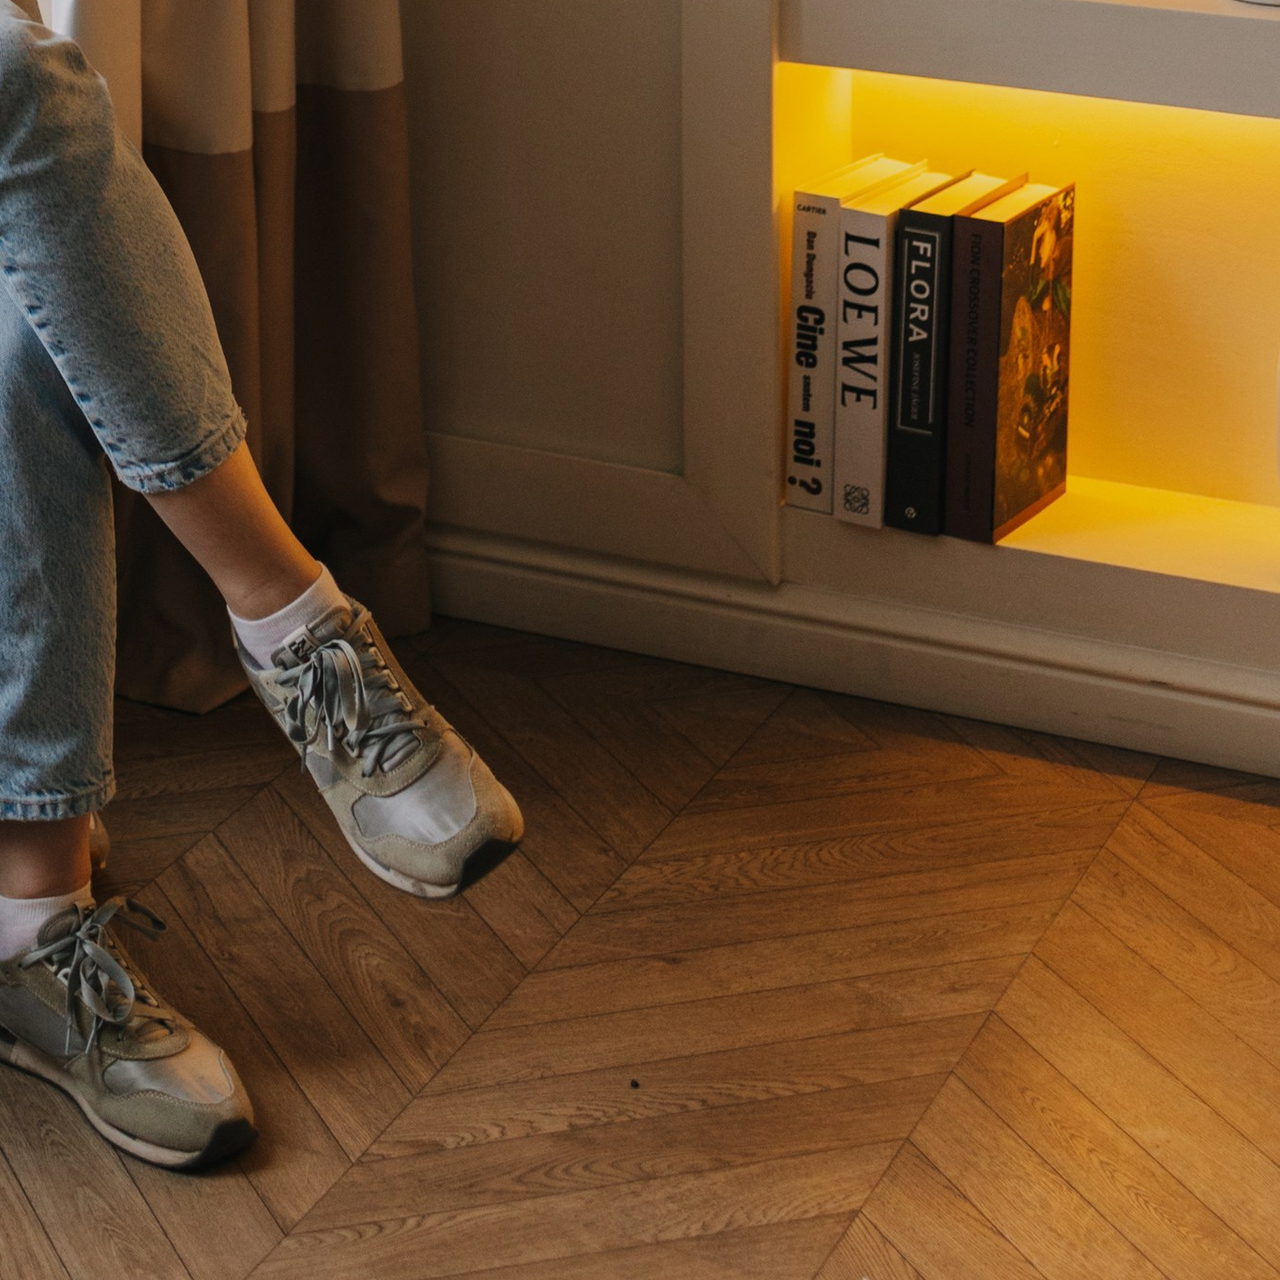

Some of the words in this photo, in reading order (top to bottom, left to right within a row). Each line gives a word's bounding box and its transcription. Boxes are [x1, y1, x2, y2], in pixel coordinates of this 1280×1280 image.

[797, 204, 827, 215] CARTIER
[806, 231, 817, 250] Dan
[971, 233, 982, 265] FION
[908, 240, 932, 342] FLORA
[968, 268, 980, 344] CROSSOVER
[795, 305, 825, 369] Cine
[841, 231, 880, 410] LOEWE
[964, 348, 977, 427] COLLECTION
[793, 419, 821, 468] noi
[787, 476, 822, 496] ?
